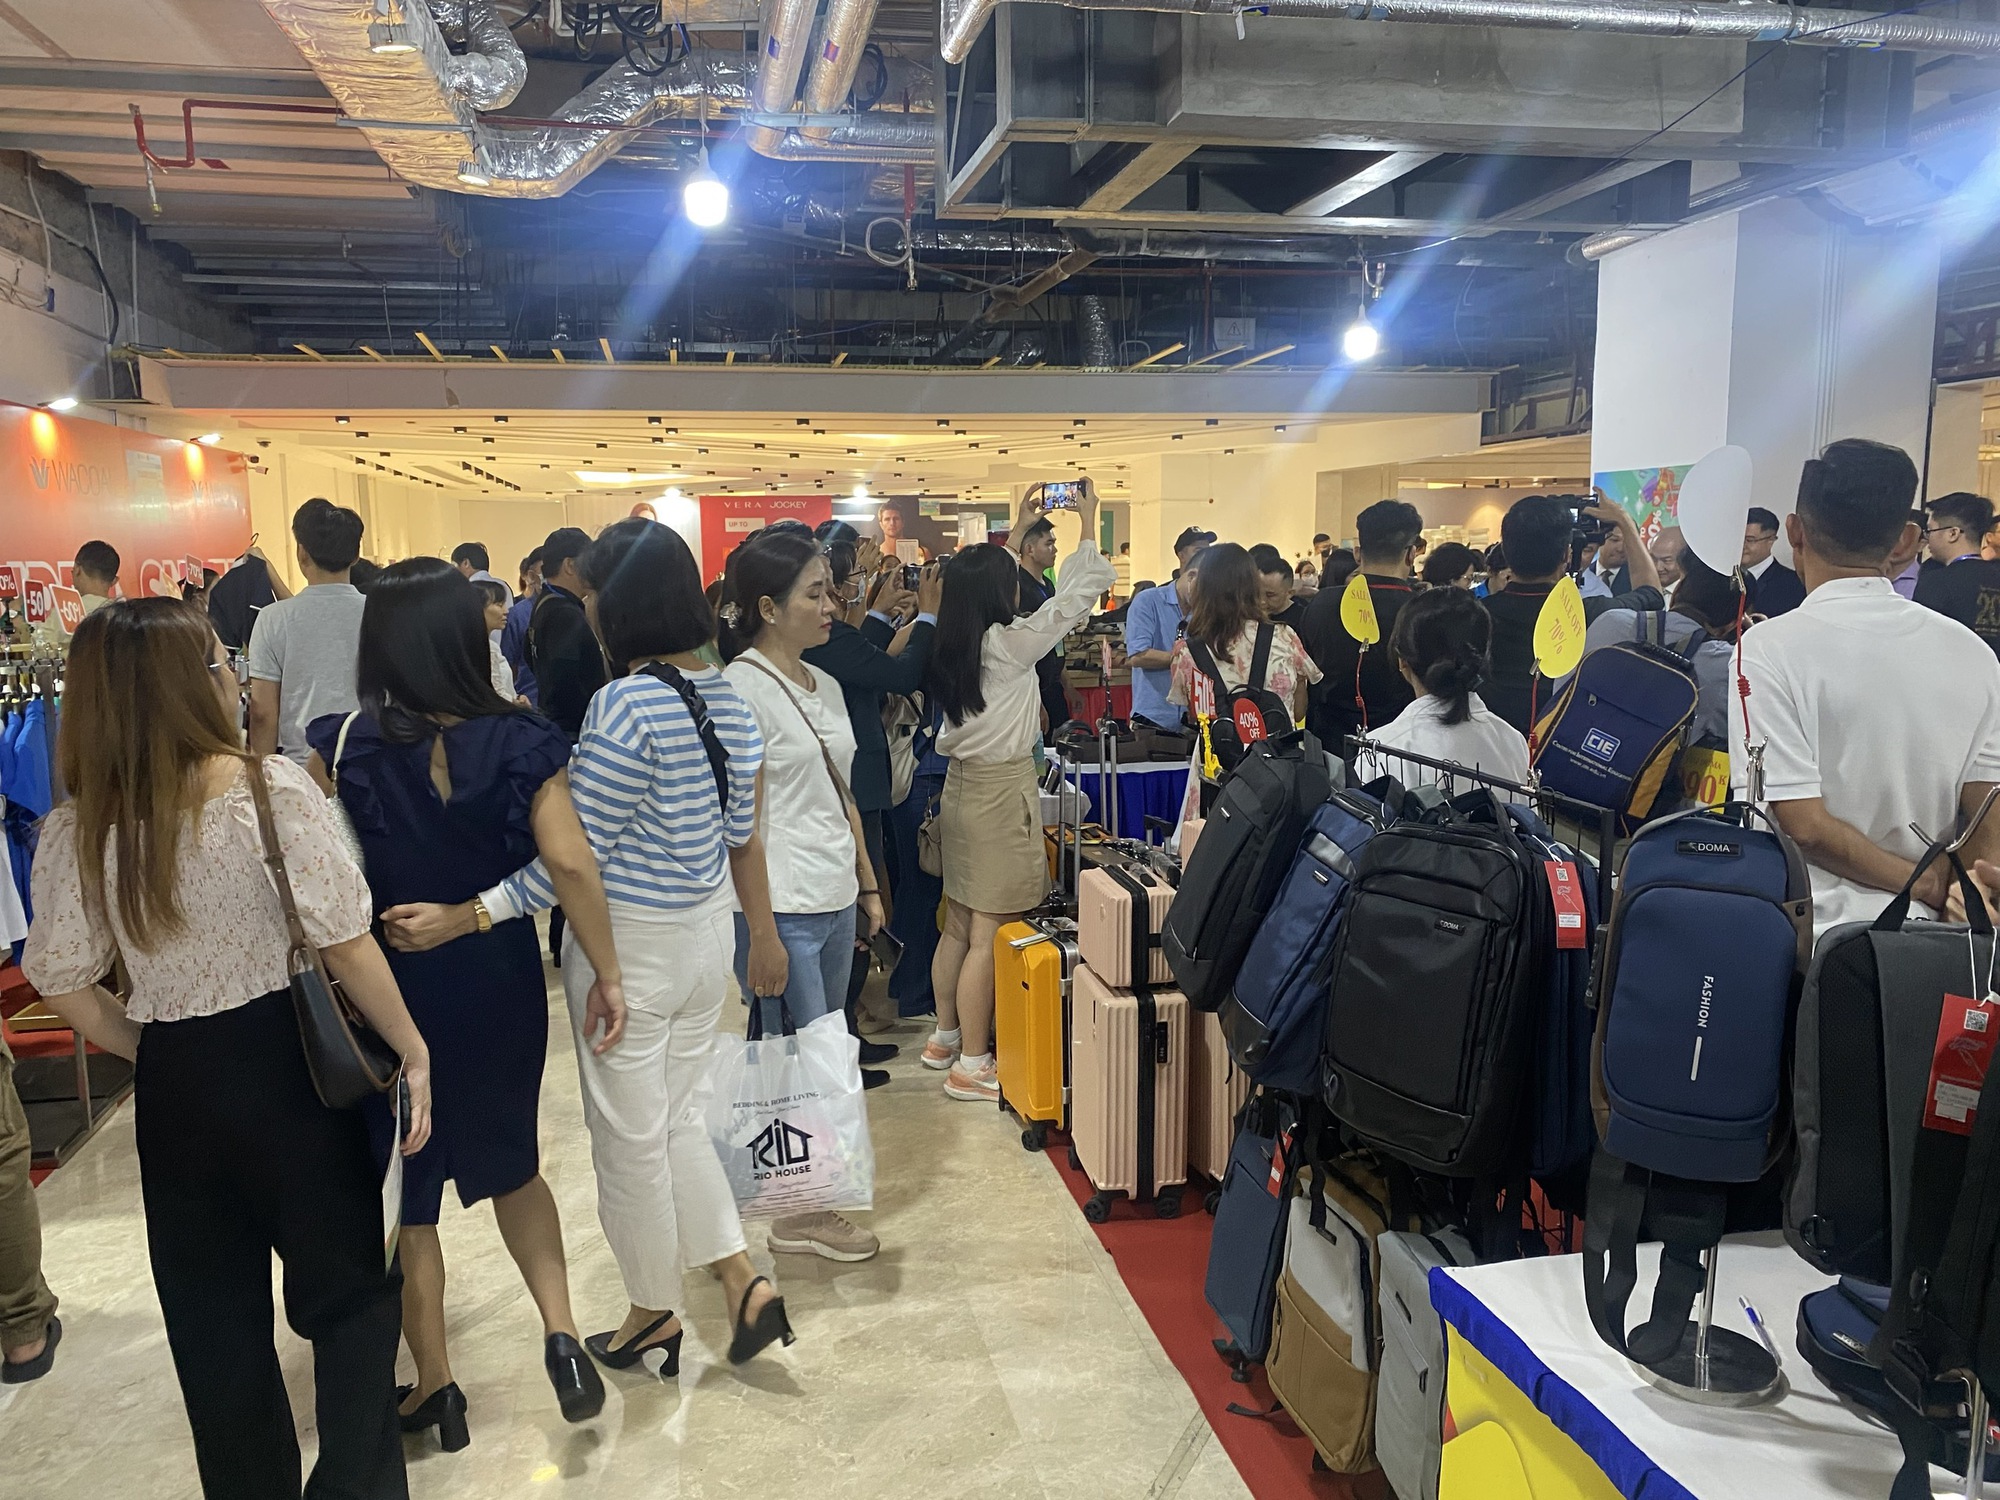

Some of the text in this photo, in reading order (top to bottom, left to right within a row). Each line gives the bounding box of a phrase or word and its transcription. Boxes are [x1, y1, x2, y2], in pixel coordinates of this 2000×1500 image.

[770, 501, 807, 509] JOCKEY
[1560, 587, 1583, 638] SALE OFF
[1548, 618, 1567, 655] 70%
[1239, 711, 1259, 728] 40%
[1249, 728, 1260, 739] OFF
[1587, 734, 1615, 755] CIE
[1698, 843, 1731, 853] DOMA
[1697, 975, 1714, 1028] FASHION
[793, 1091, 820, 1101] LIVING
[753, 1164, 812, 1181] RIO HOUSE
